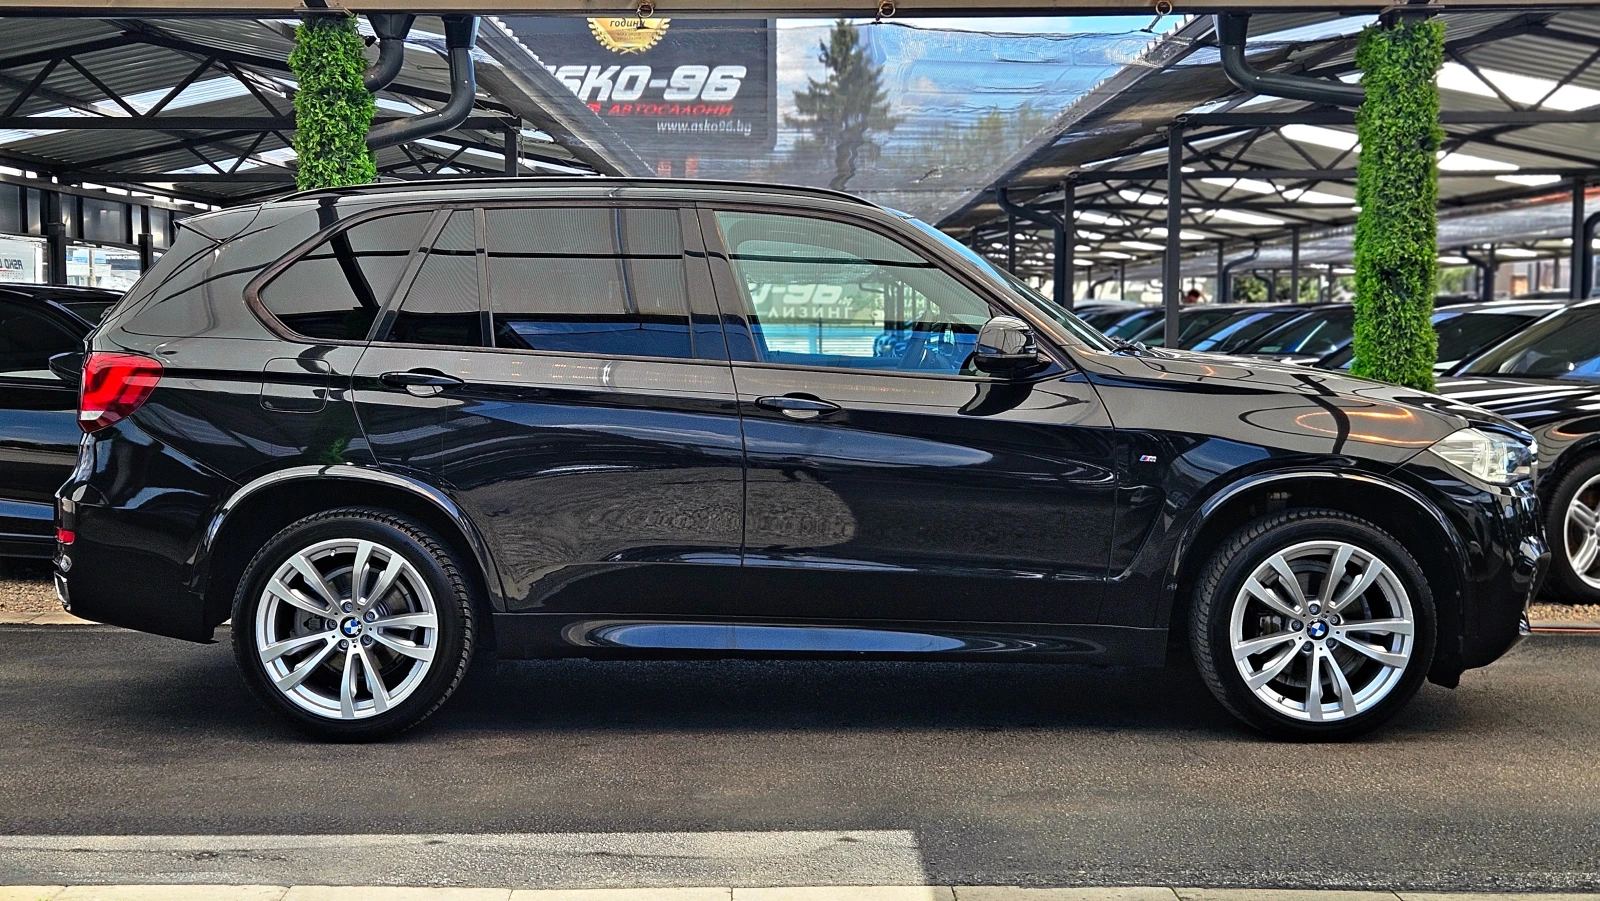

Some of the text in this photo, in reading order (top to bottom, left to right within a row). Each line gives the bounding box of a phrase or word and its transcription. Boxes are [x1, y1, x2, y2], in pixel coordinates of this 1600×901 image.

[607, 102, 733, 116] АВТОСАЛОНИ
[657, 118, 752, 136] www.asko96.bg
[768, 306, 853, 318] ЛИЗИНГ
